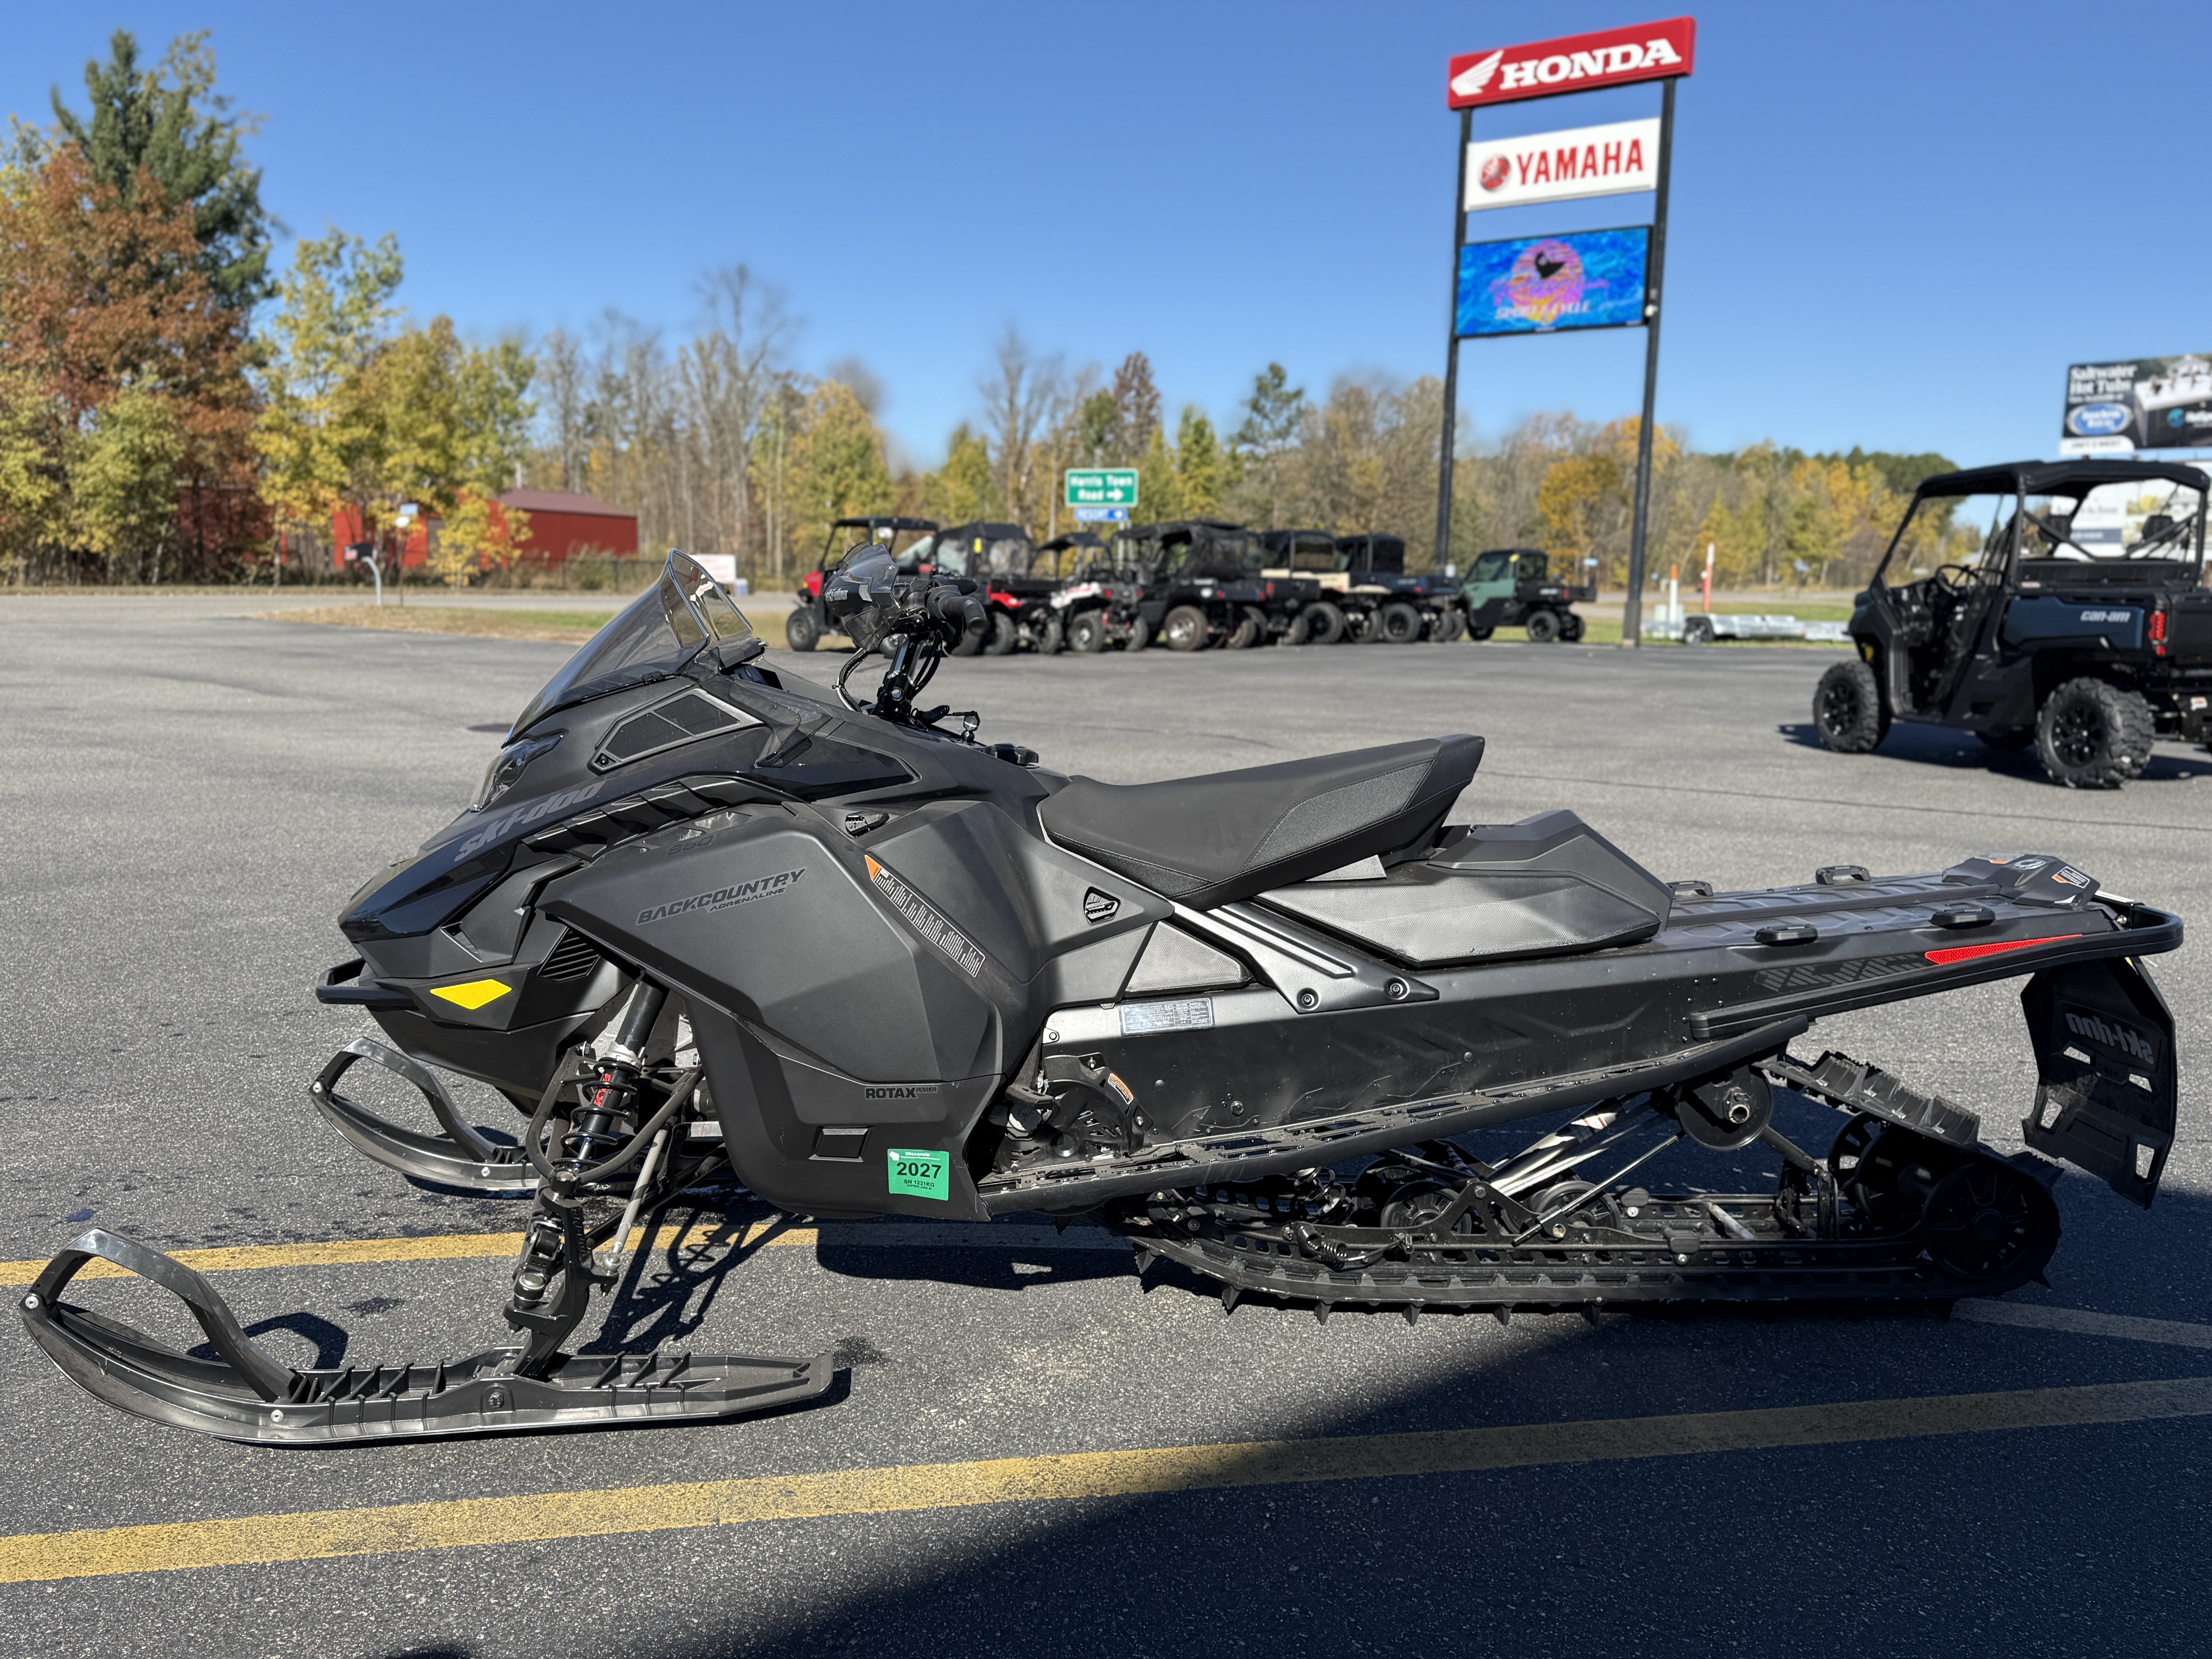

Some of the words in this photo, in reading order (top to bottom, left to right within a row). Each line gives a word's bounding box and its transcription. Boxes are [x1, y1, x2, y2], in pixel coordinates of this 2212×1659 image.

[1499, 38, 1682, 90] HONDA
[1516, 138, 1644, 185] YAMAHA
[2069, 381, 2094, 394] Hot
[2097, 378, 2132, 393] Tubs
[1077, 488, 1104, 501] Road
[2080, 610, 2131, 623] can-am
[454, 781, 606, 862] ski-doo
[638, 868, 806, 924] BACKCOUNTRY
[709, 888, 785, 912] ADRENALINE
[866, 1087, 916, 1098] ROTAX
[896, 1162, 941, 1179] 2027
